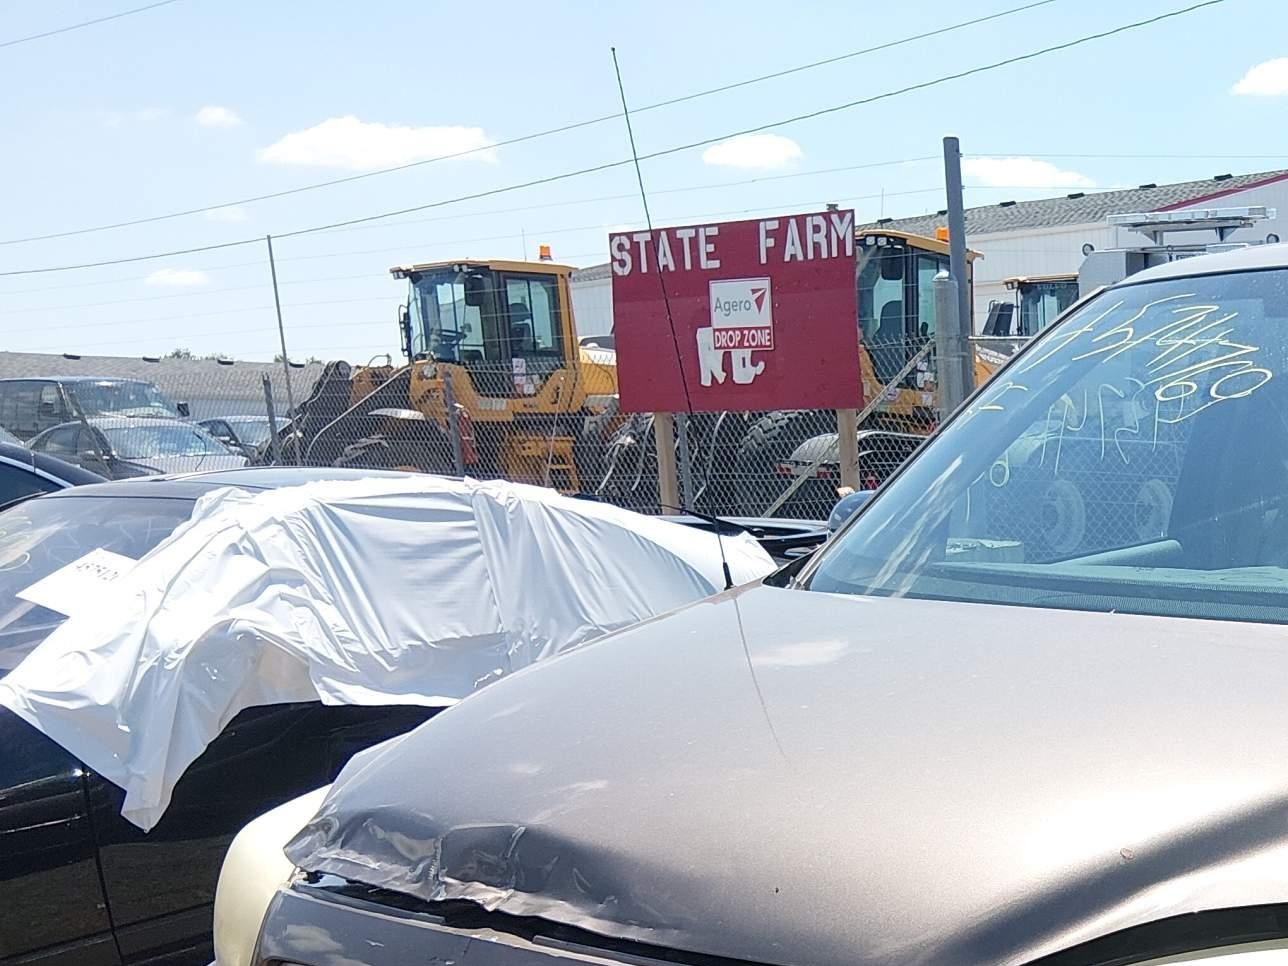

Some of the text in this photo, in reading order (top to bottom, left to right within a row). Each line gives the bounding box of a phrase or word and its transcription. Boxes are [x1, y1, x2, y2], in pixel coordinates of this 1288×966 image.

[611, 212, 854, 276] STATE FARM
[714, 297, 752, 317] Agero
[714, 328, 771, 348] DROP ZONE
